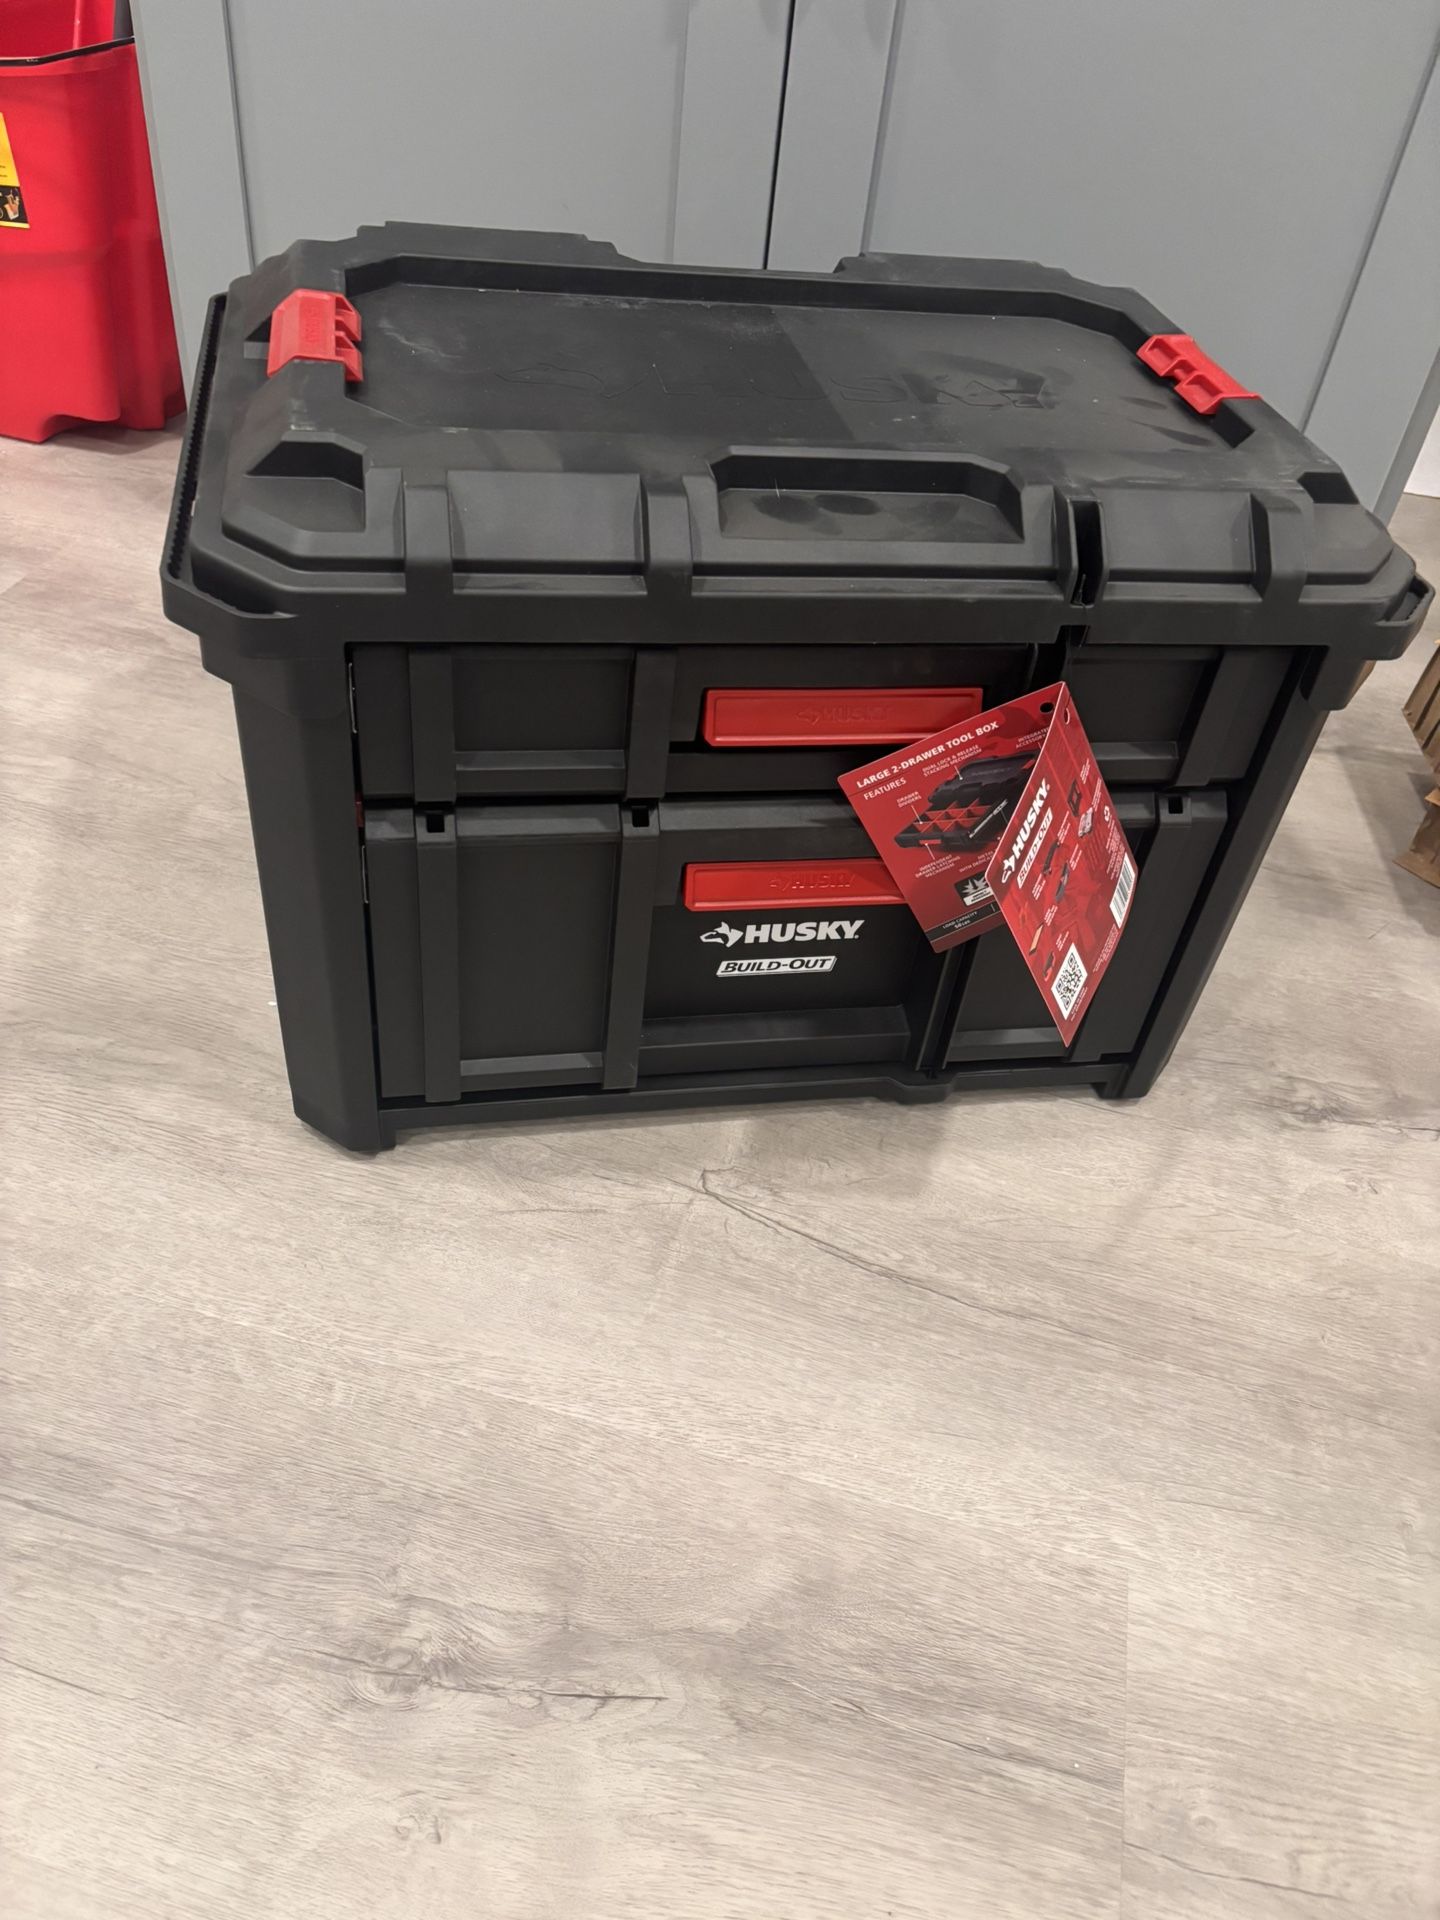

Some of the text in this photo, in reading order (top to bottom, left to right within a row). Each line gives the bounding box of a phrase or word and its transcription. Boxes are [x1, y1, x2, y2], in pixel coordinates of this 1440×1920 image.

[856, 721, 999, 789] LARGE 2-DRAWER TOOL BOX
[863, 777, 907, 801] FEATURES
[1012, 777, 1049, 859] HUSKY
[744, 920, 865, 944] HUSKY
[720, 957, 832, 974] BUILD-OUT
